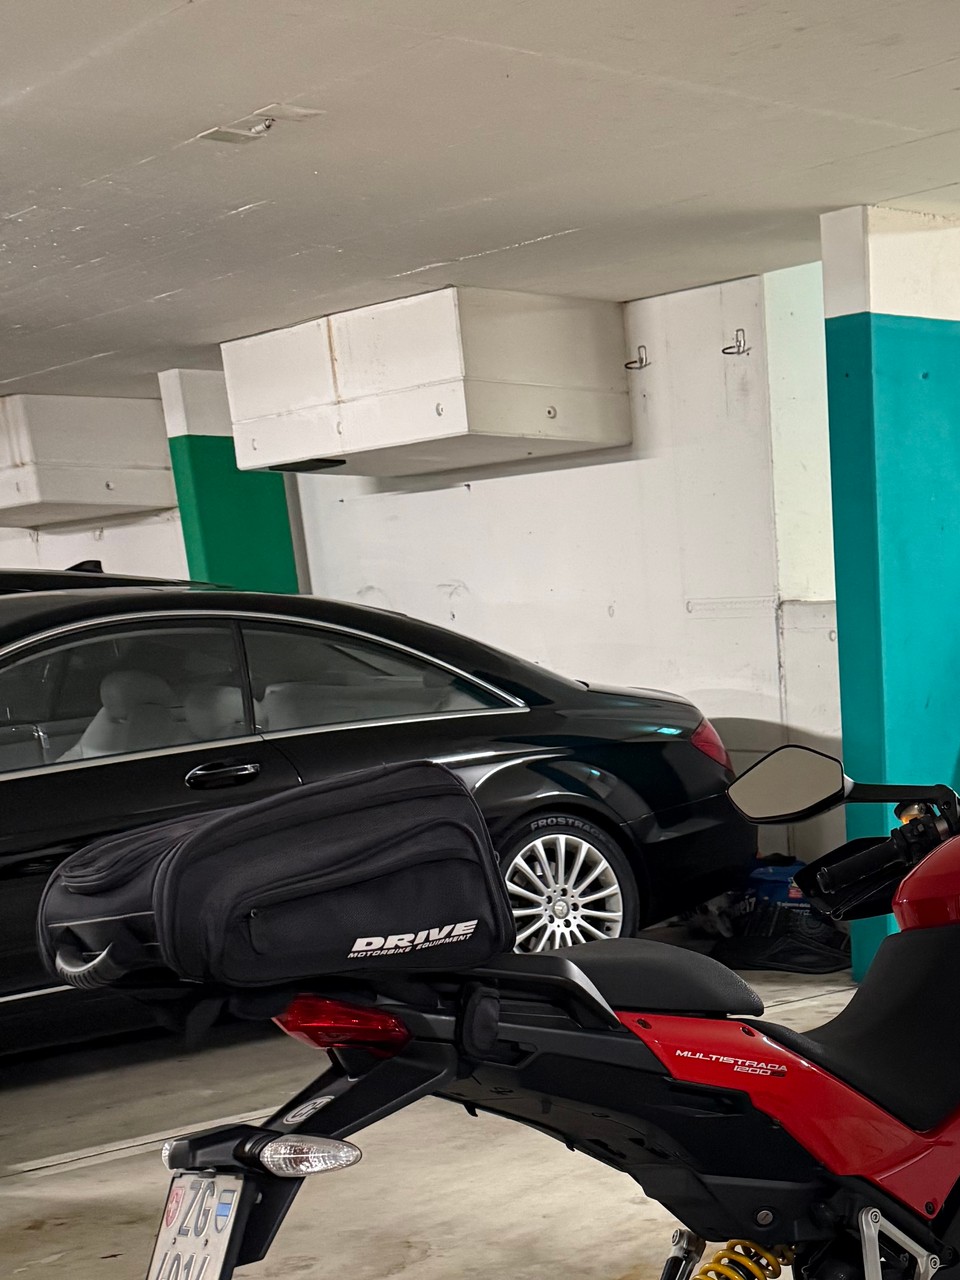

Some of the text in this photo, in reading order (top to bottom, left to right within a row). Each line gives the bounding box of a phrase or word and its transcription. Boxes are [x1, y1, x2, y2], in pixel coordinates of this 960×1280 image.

[347, 933, 472, 959] MOTORBIKE EQUIPMENT
[351, 919, 478, 953] DRIVE
[675, 1049, 788, 1072] MULTISTRADA
[733, 1065, 771, 1076] 1200
[177, 1180, 217, 1238] ZG
